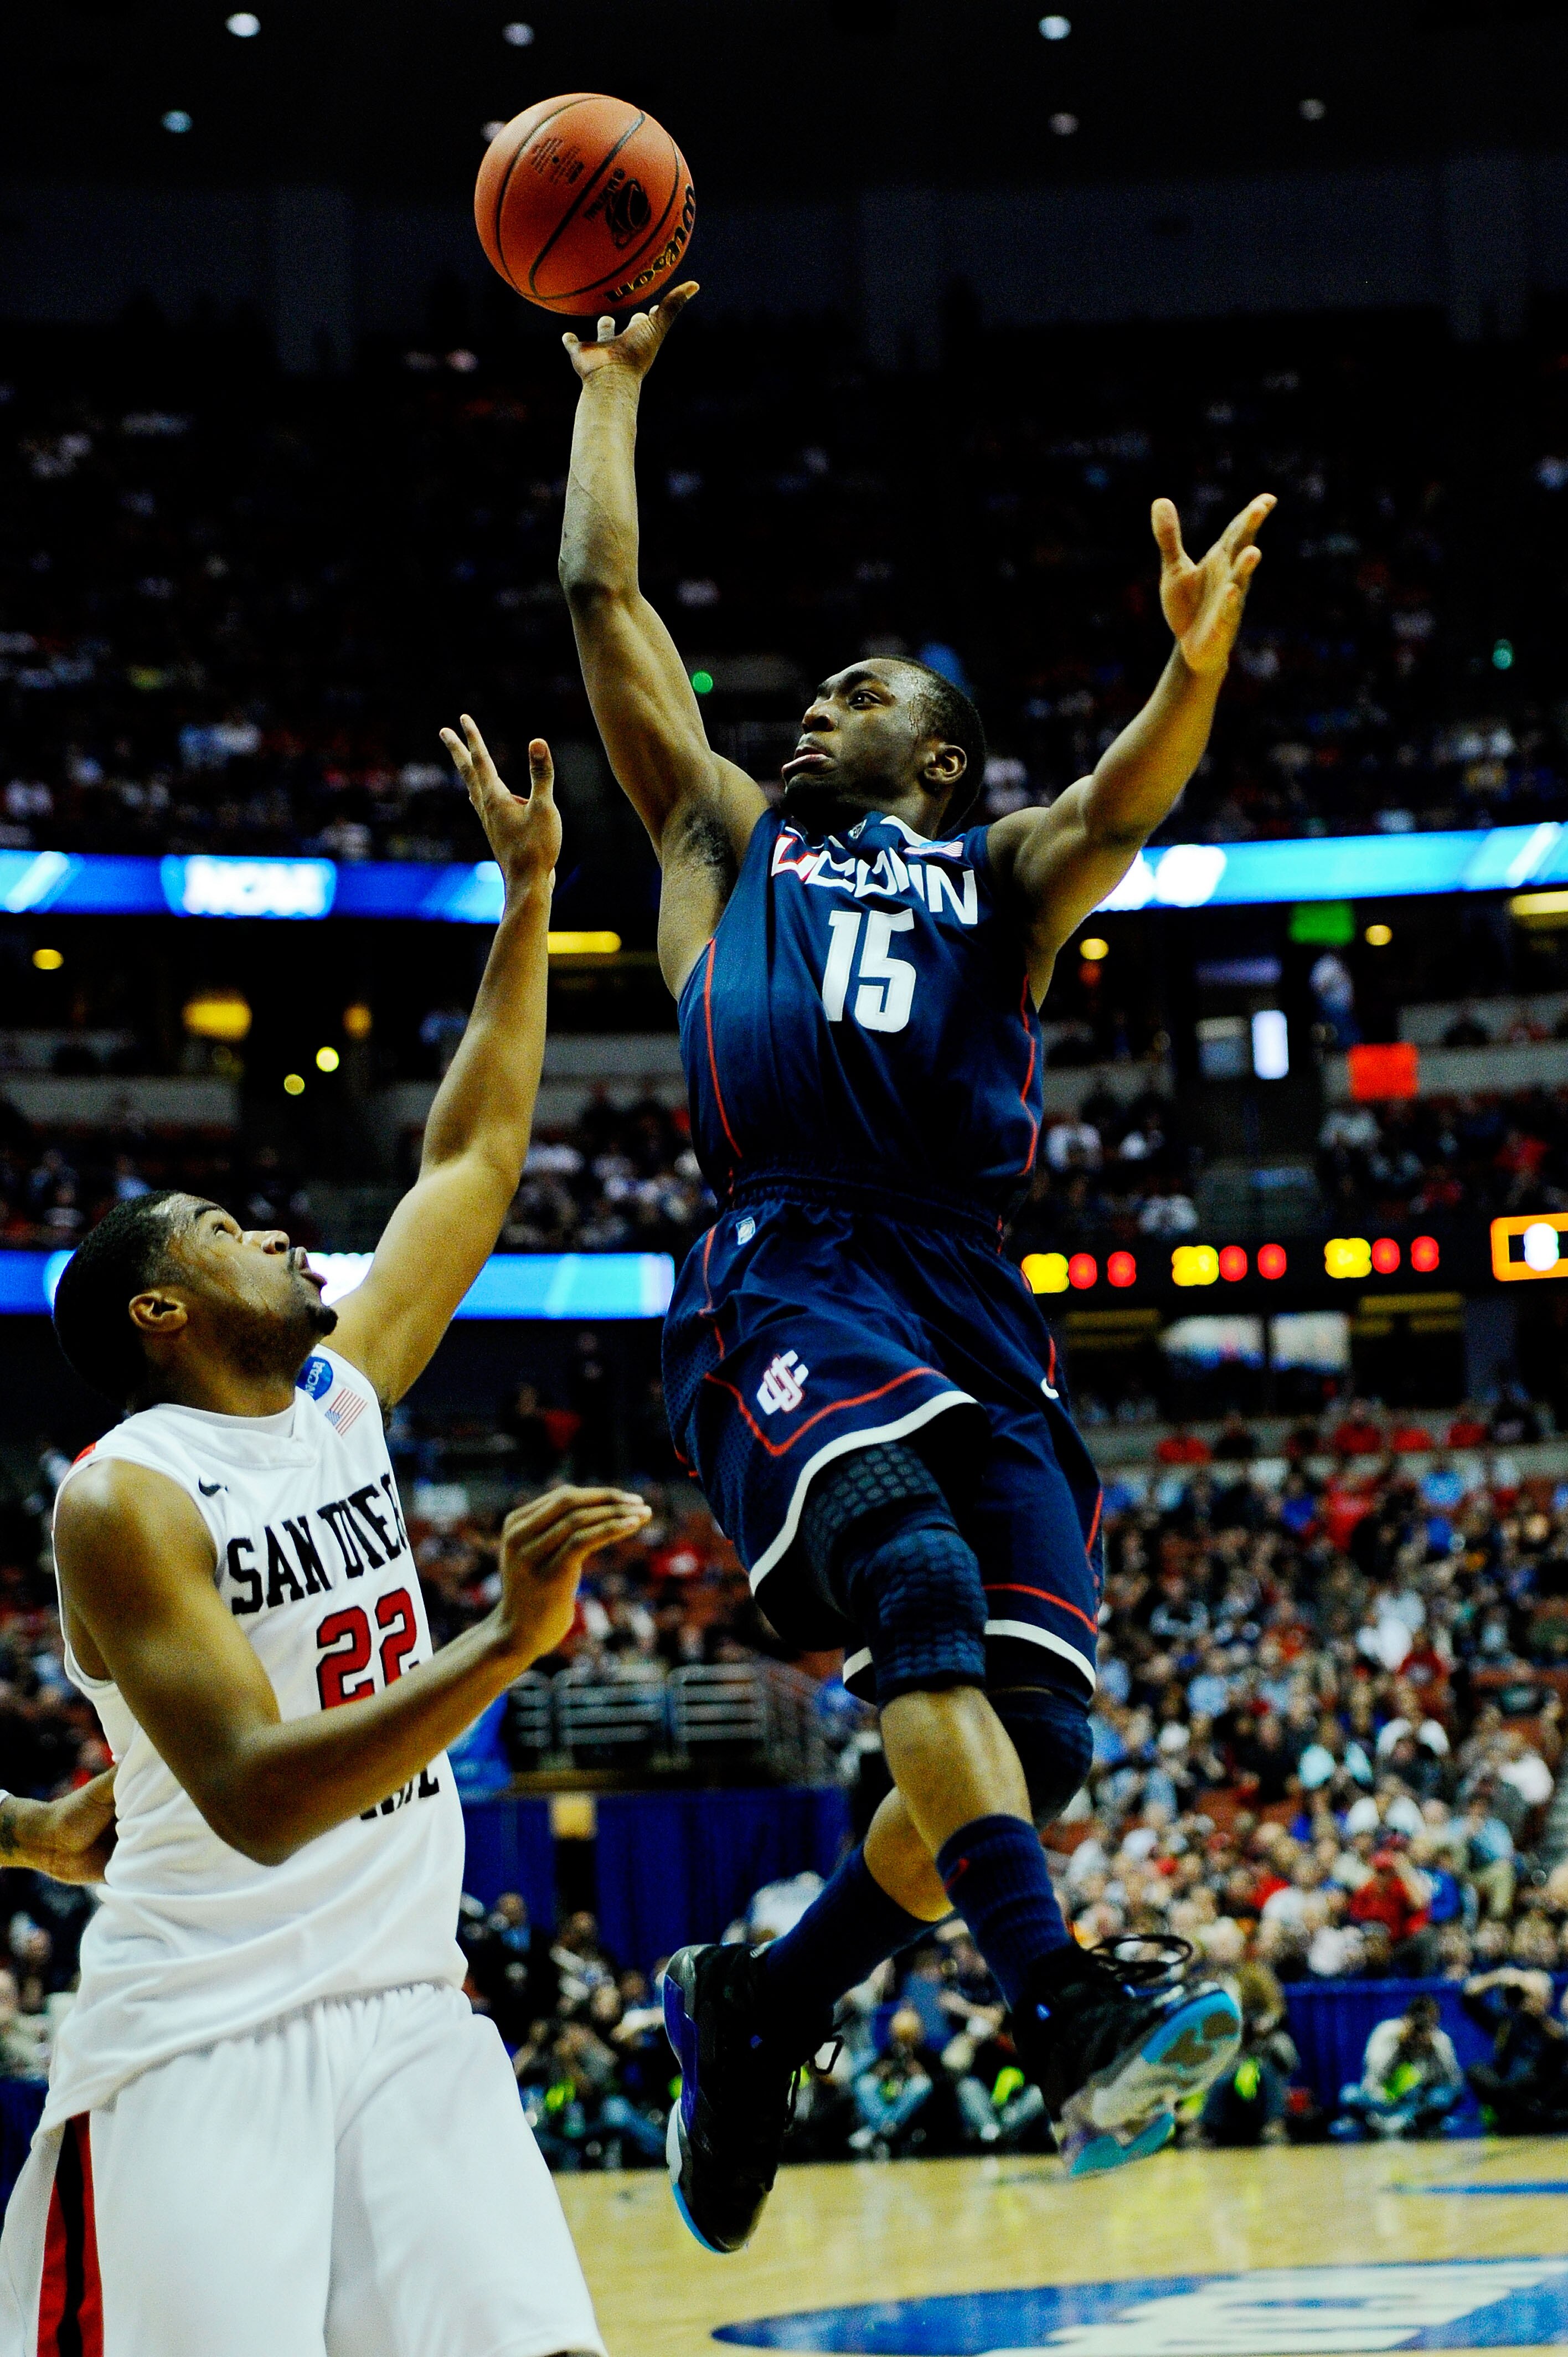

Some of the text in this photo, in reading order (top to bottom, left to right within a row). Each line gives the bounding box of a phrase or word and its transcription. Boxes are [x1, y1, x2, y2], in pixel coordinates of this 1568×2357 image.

[822, 909, 916, 1032] 15
[227, 1515, 333, 1615] SAN
[316, 1587, 420, 1710] 22
